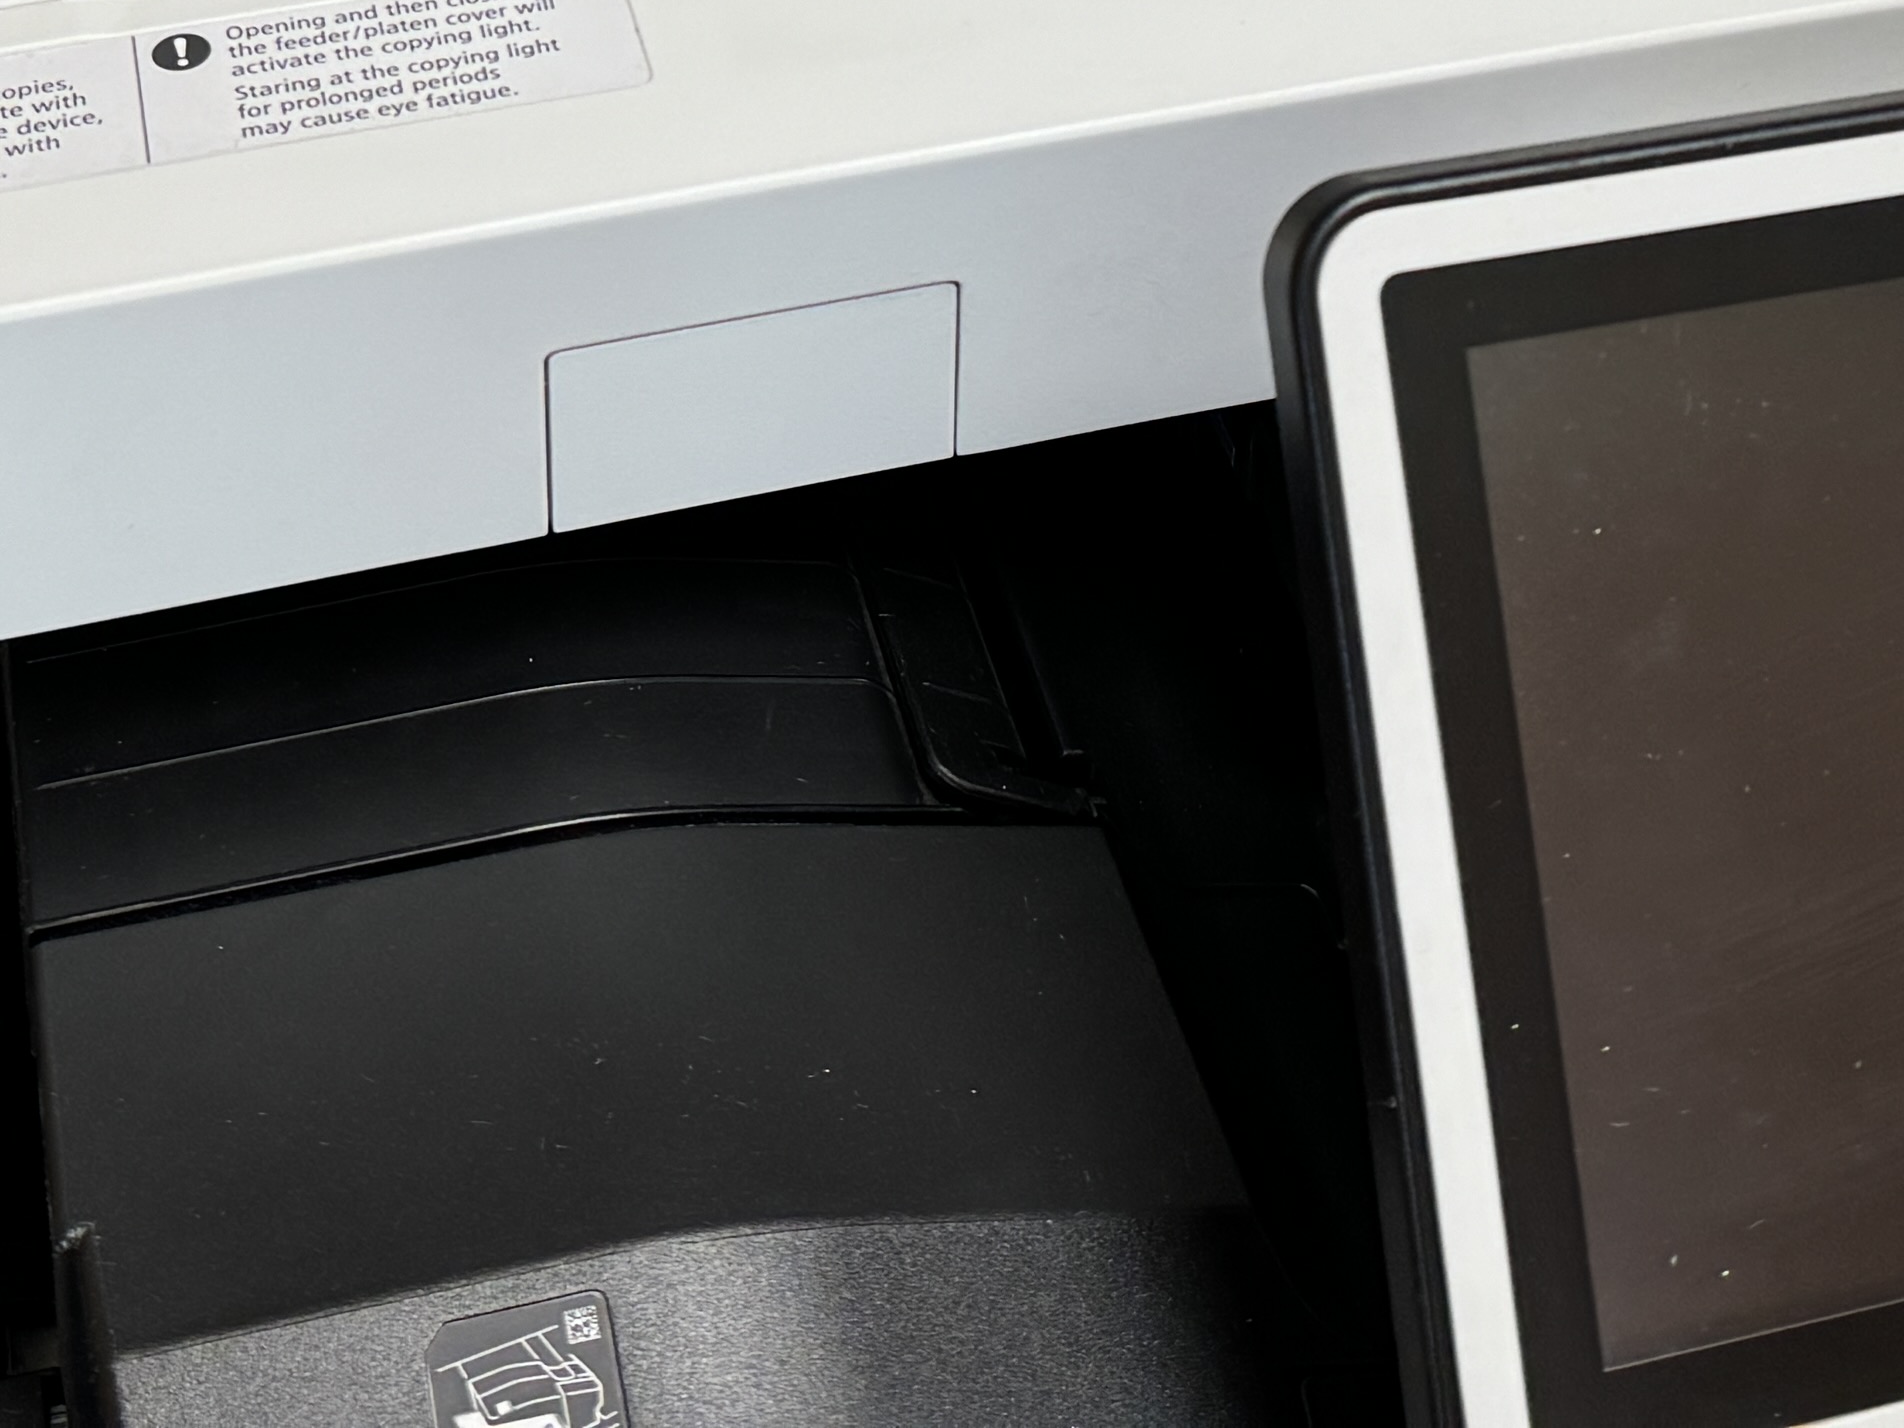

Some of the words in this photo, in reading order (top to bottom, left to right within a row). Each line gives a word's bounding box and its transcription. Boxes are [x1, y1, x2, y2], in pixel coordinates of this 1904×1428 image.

[226, 16, 326, 40] Opening
[335, 4, 378, 24] and
[385, 0, 438, 17] then
[228, 42, 267, 59] the
[275, 18, 438, 51] feeder/platen
[445, 7, 506, 26] cover
[232, 53, 326, 77] activate
[334, 45, 373, 61] the
[381, 31, 472, 54] copying
[479, 20, 540, 39] light.
[234, 78, 321, 101] Staring
[330, 71, 354, 86] at
[360, 64, 400, 81] the
[407, 50, 500, 74] copying
[506, 39, 560, 59] light
[31, 92, 87, 114] with
[238, 103, 272, 119] for
[280, 79, 404, 115] prolonged
[412, 66, 501, 94] periods
[241, 120, 292, 138] may
[300, 108, 369, 129] cause
[378, 101, 418, 117] eye
[426, 86, 518, 109] fatigue.
[4, 135, 60, 157] with
[16, 113, 103, 143] device,
